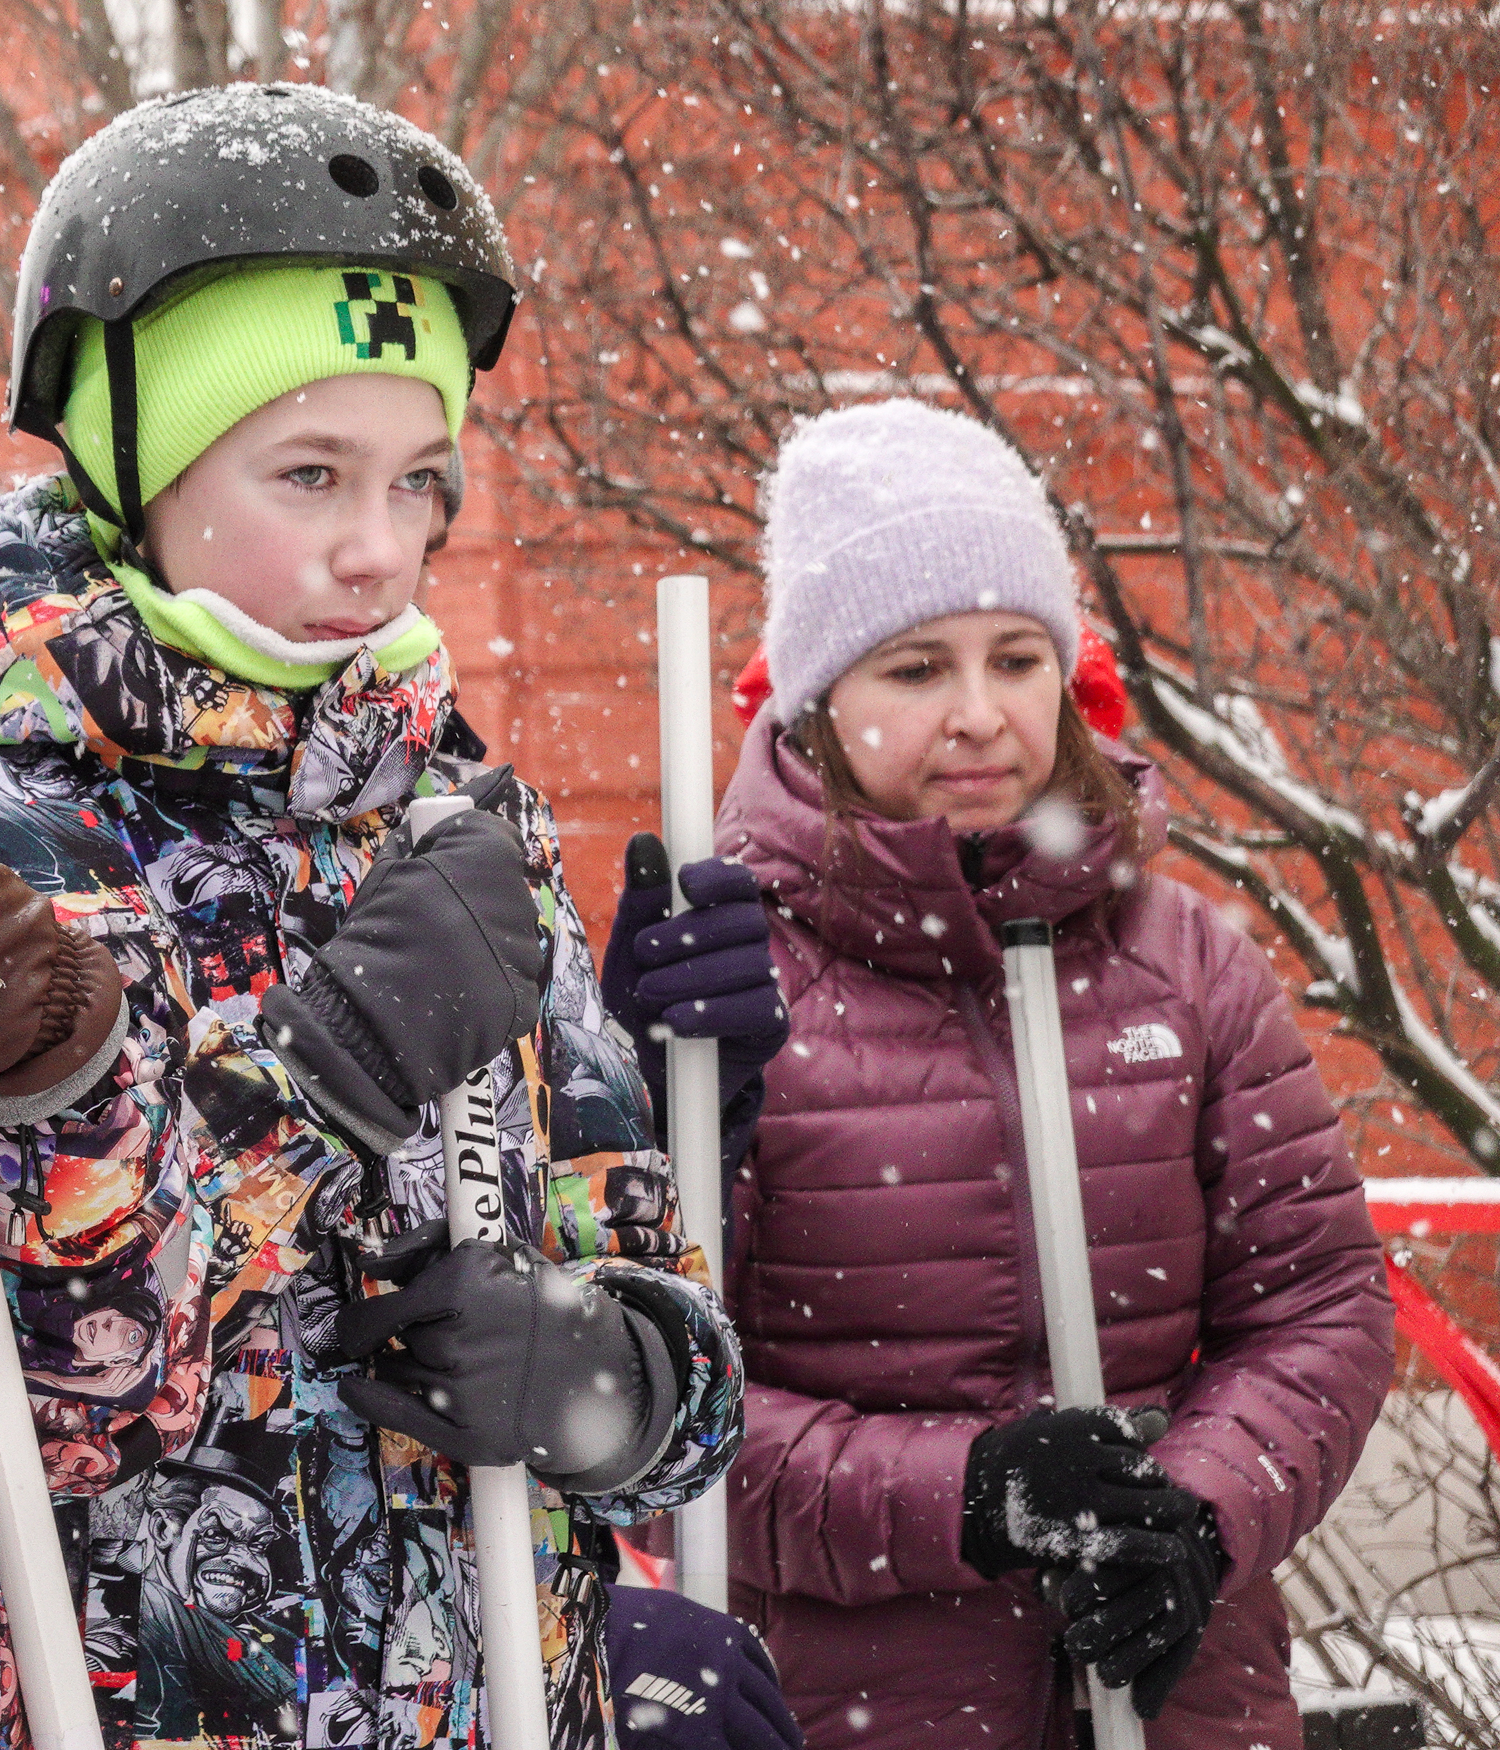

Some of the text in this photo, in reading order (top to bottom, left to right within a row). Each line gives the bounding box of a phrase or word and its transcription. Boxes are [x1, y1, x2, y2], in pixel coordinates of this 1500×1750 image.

[1122, 1024, 1151, 1040] THE
[1105, 1037, 1153, 1054] NORTH
[1124, 1049, 1158, 1064] FACE
